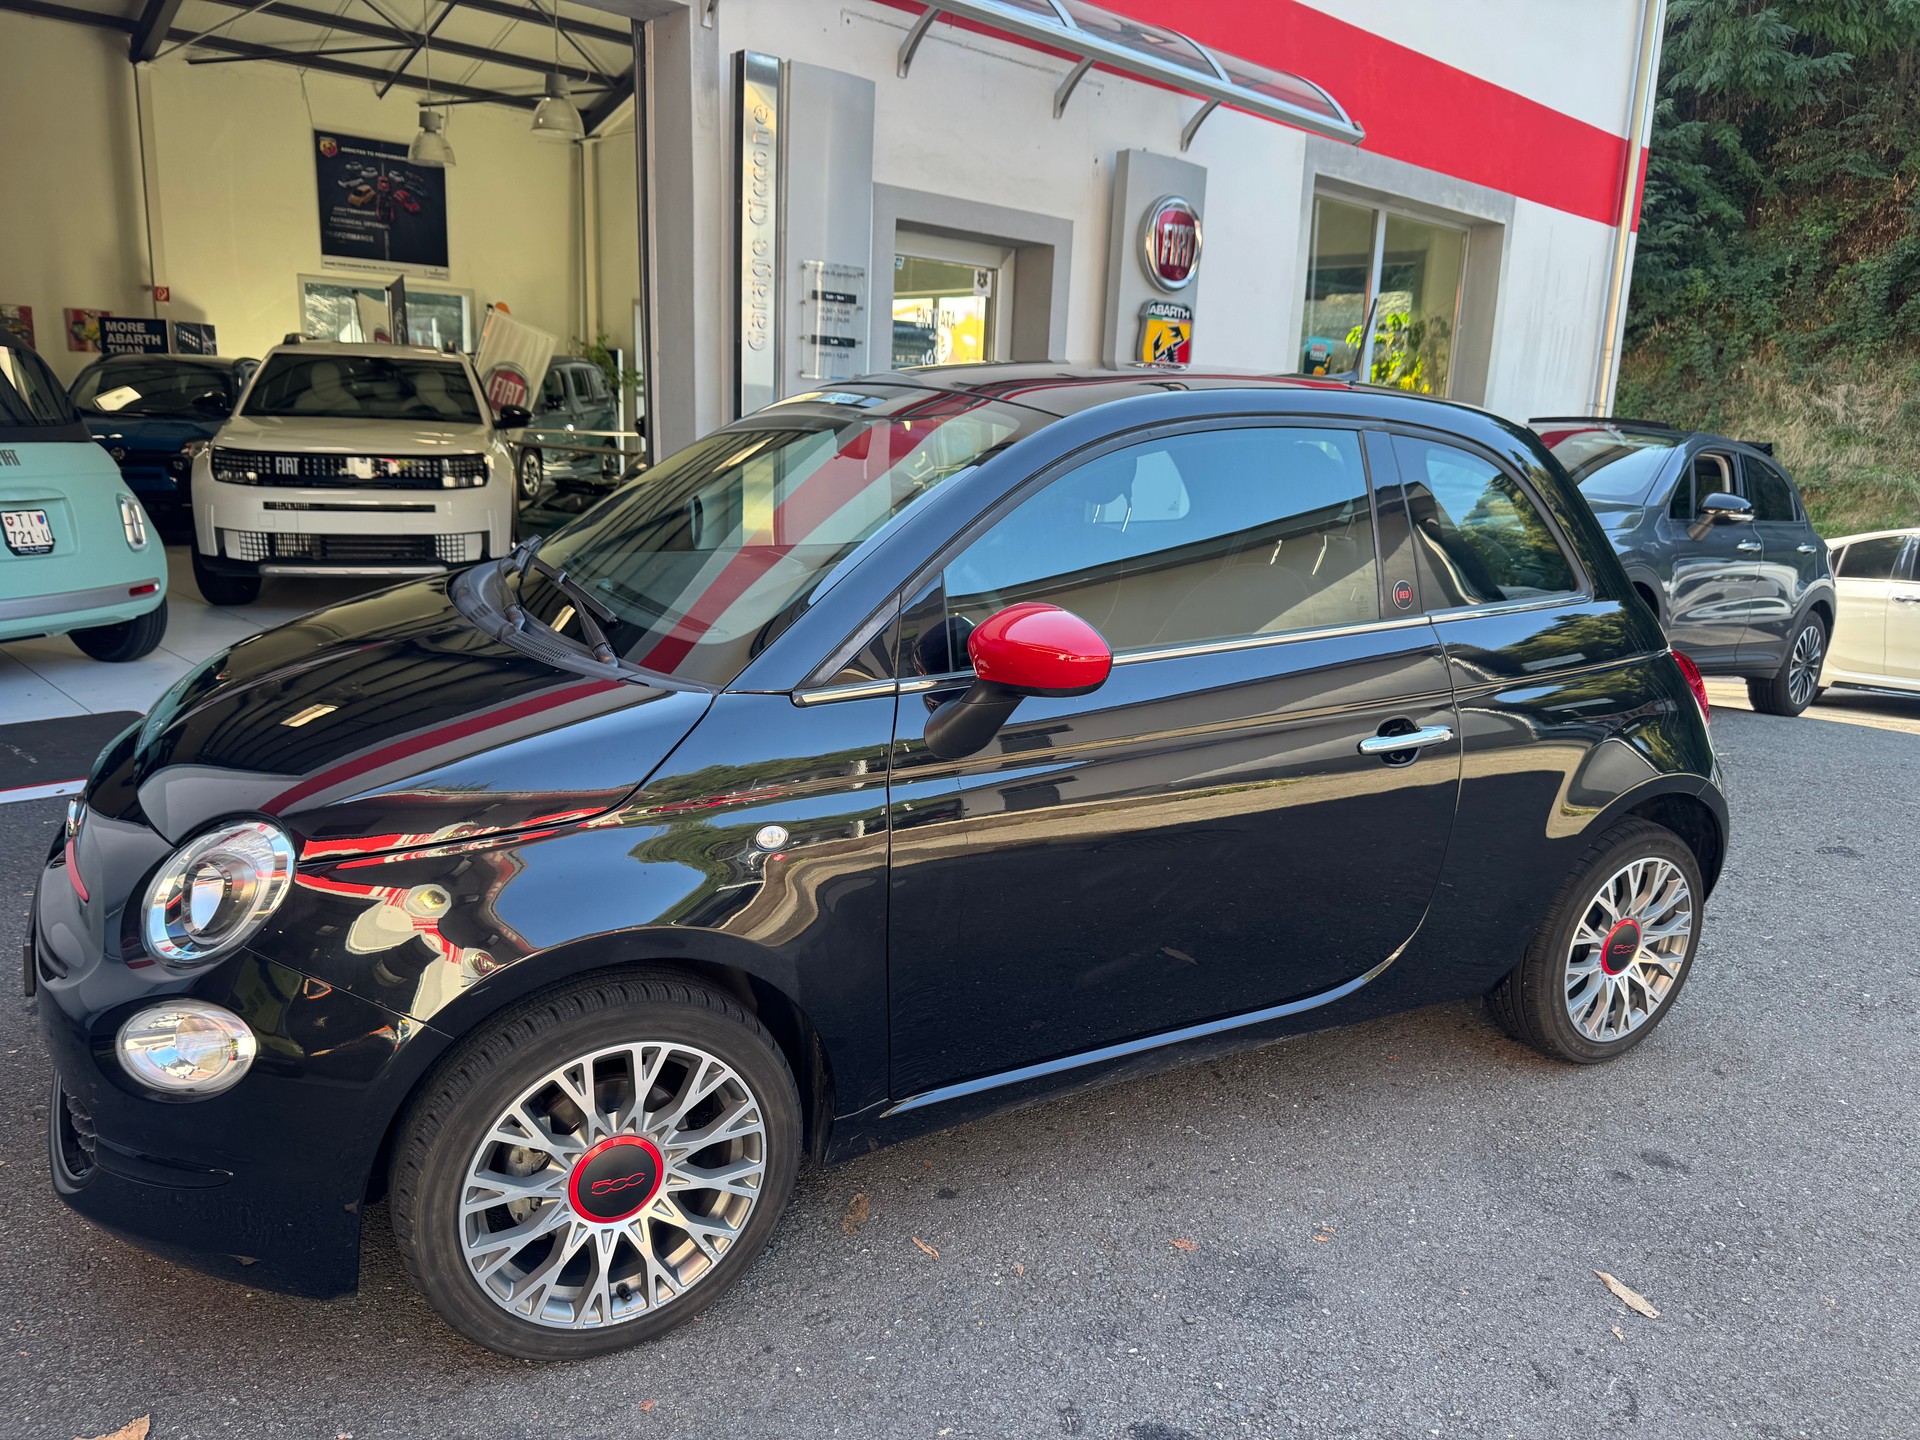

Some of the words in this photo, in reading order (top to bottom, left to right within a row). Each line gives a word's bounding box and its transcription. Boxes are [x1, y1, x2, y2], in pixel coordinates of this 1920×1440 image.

[748, 104, 769, 226] Ciccone
[1160, 223, 1195, 268] FIAT
[748, 238, 771, 351] Garage
[1149, 304, 1190, 319] ABARTH
[105, 321, 146, 333] MORE
[106, 333, 162, 346] ABARTH
[107, 344, 144, 354] THAN
[490, 376, 524, 405] FIAT
[275, 456, 300, 475] FIAT
[591, 1172, 646, 1196] 500
